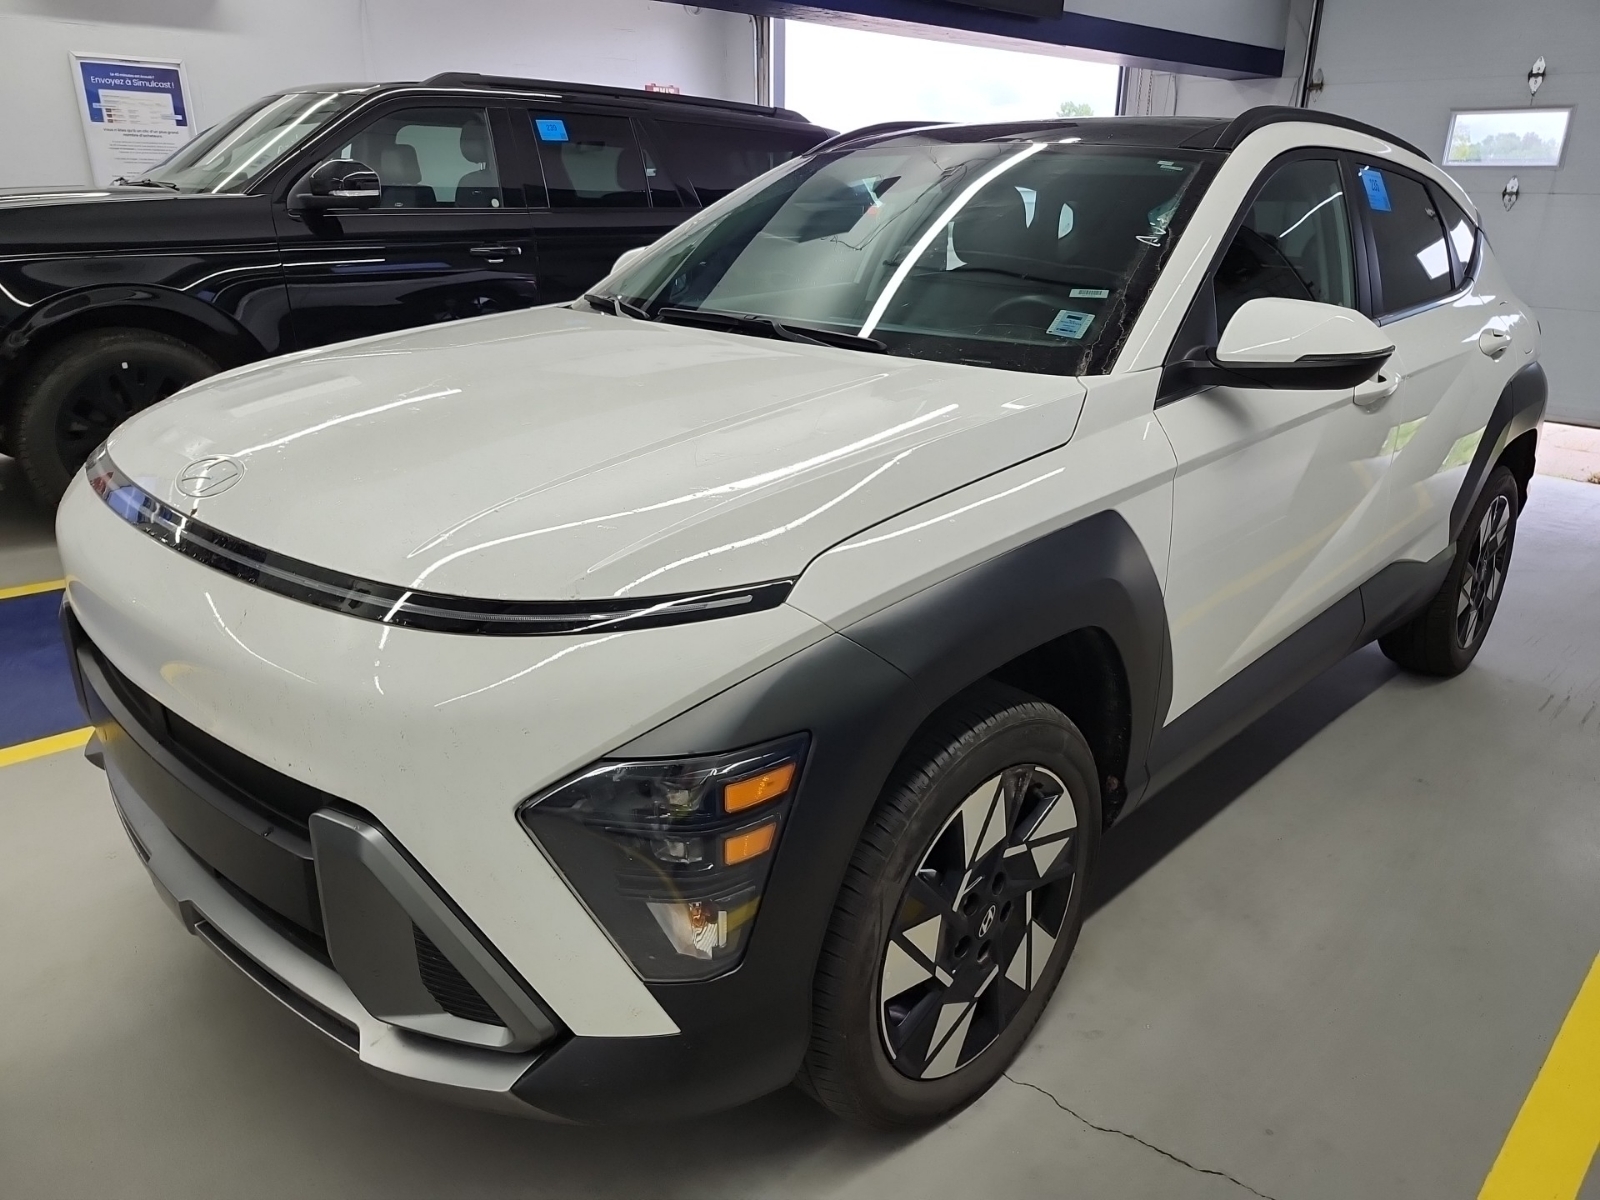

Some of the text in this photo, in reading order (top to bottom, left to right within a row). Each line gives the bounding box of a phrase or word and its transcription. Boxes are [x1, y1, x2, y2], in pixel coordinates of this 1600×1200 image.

[91, 76, 124, 87] Envoyez
[125, 78, 132, 86] à
[132, 79, 171, 89] Simulcast
